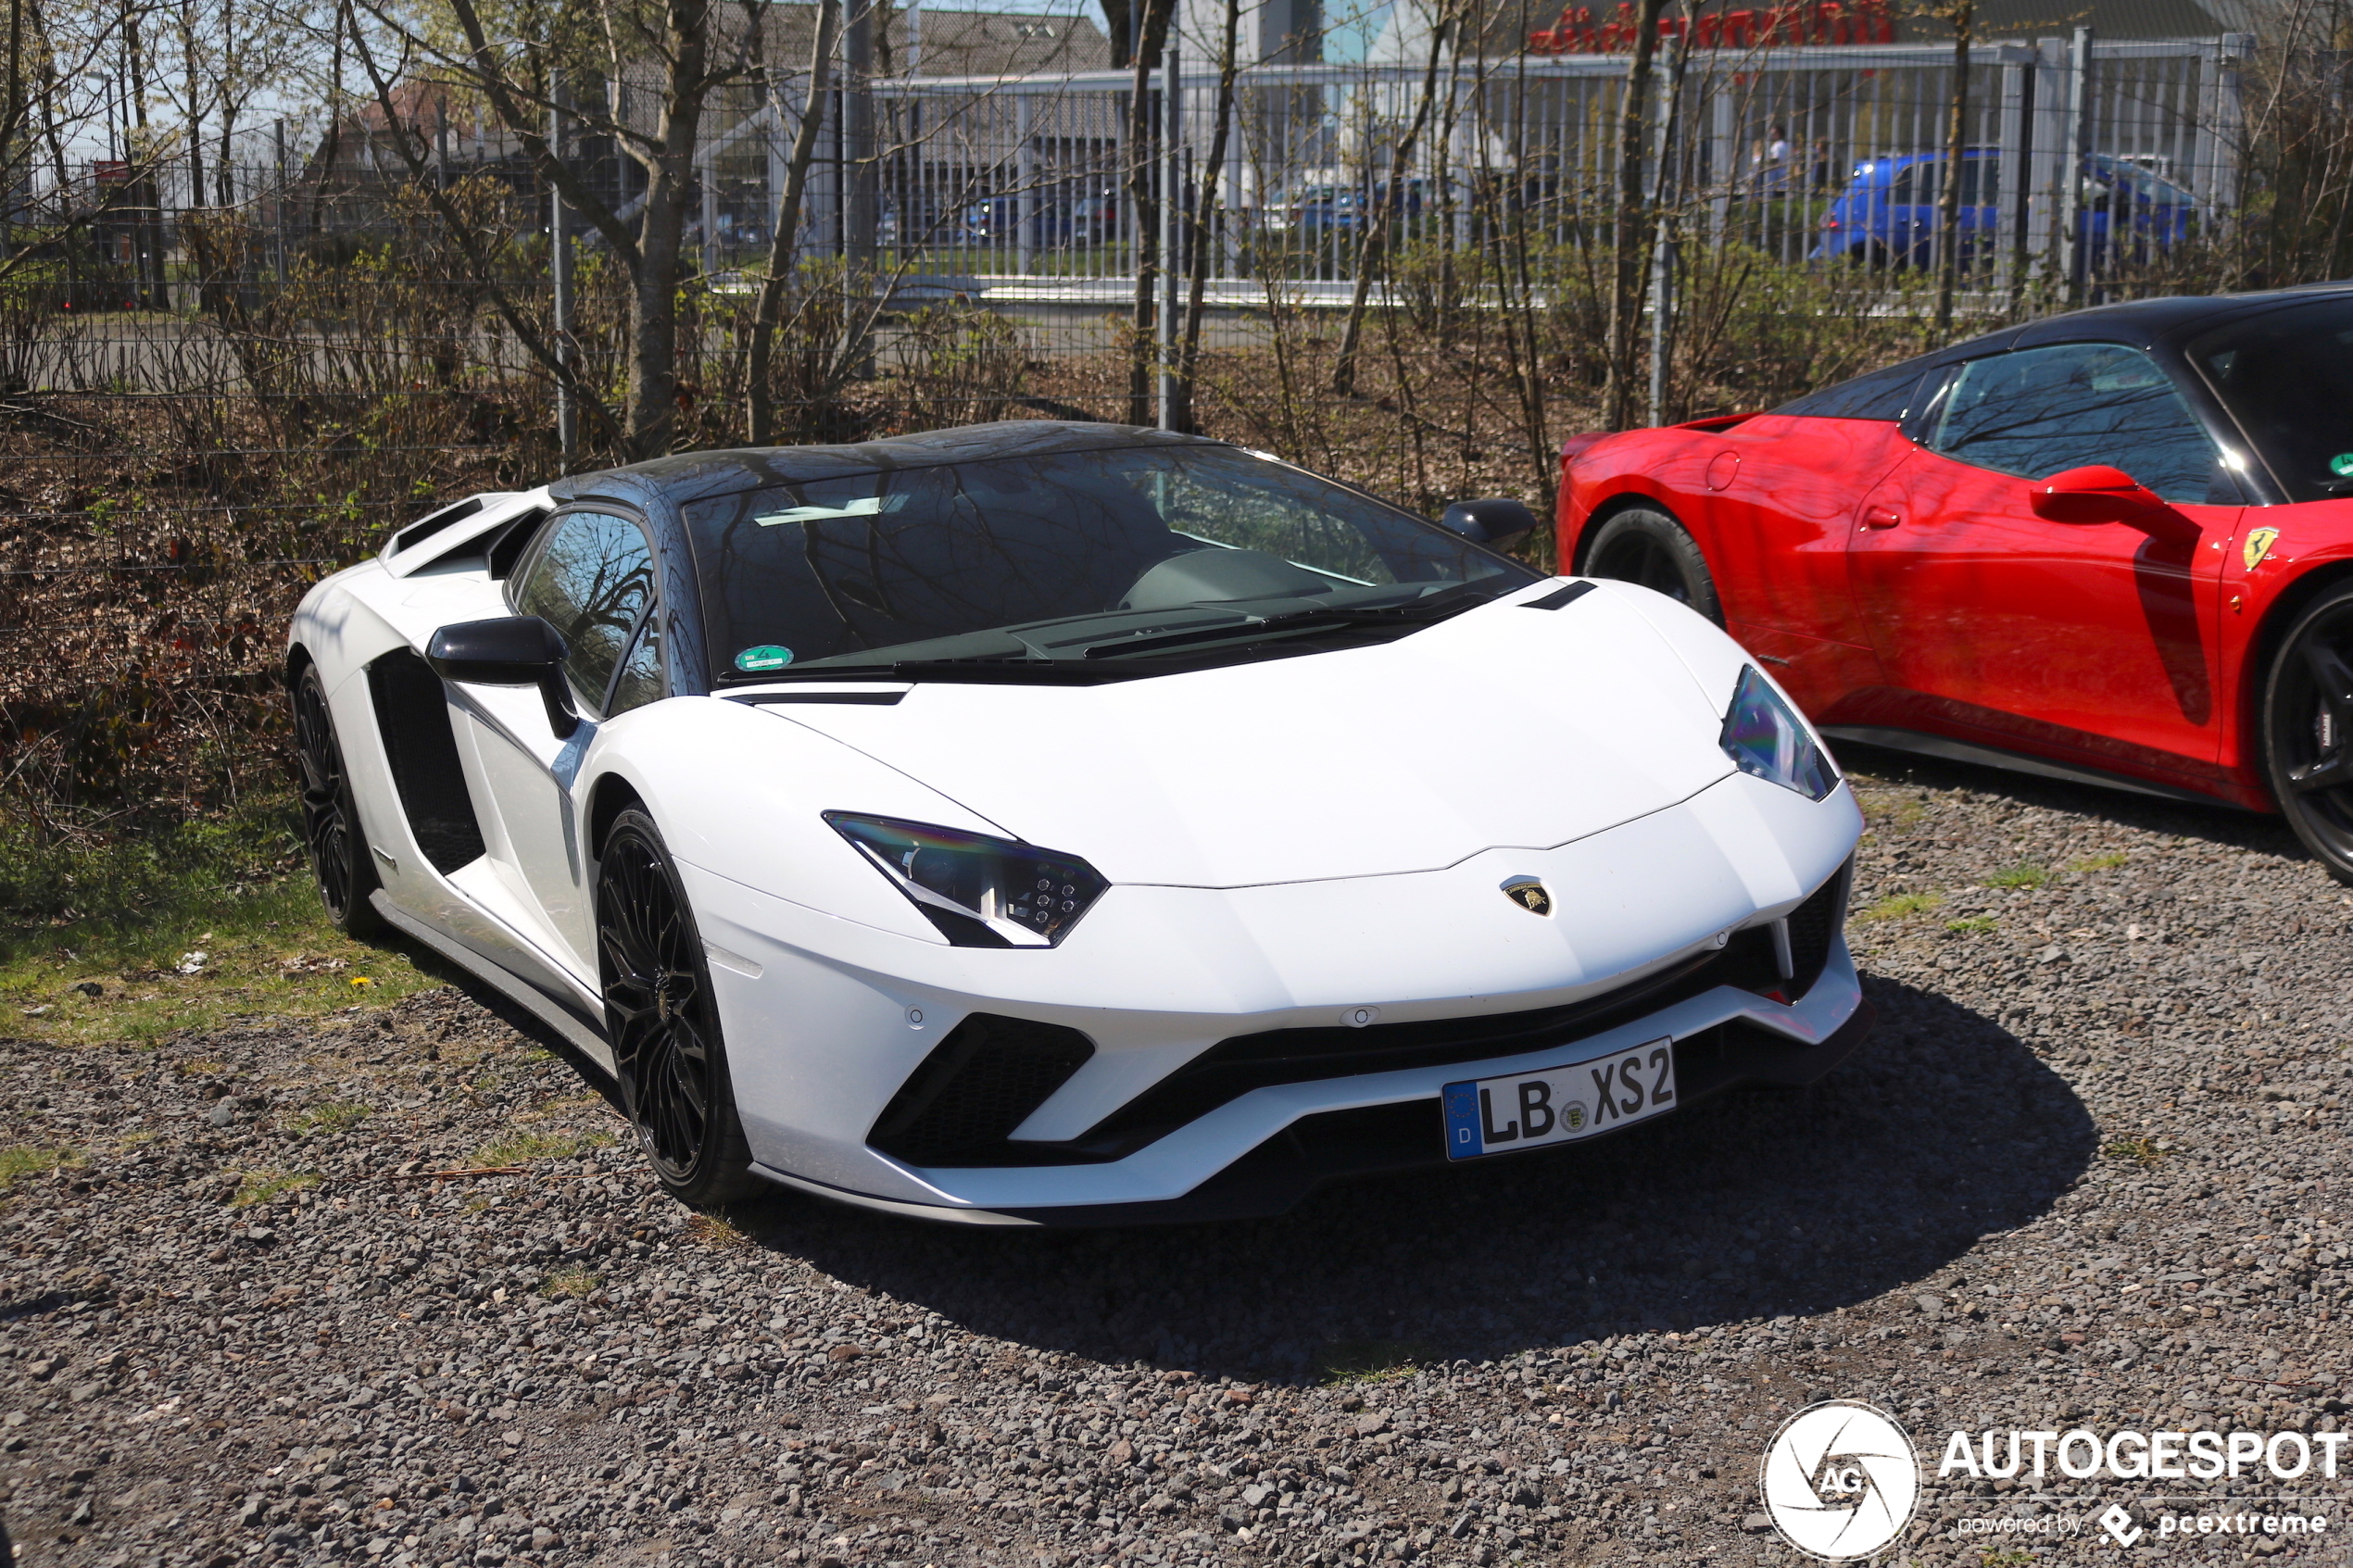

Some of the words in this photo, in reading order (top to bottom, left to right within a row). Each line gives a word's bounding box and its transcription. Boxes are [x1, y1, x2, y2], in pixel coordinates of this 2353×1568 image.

[757, 648, 771, 659] 4
[1479, 1081, 1555, 1145] LB
[1459, 1127, 1471, 1144] D
